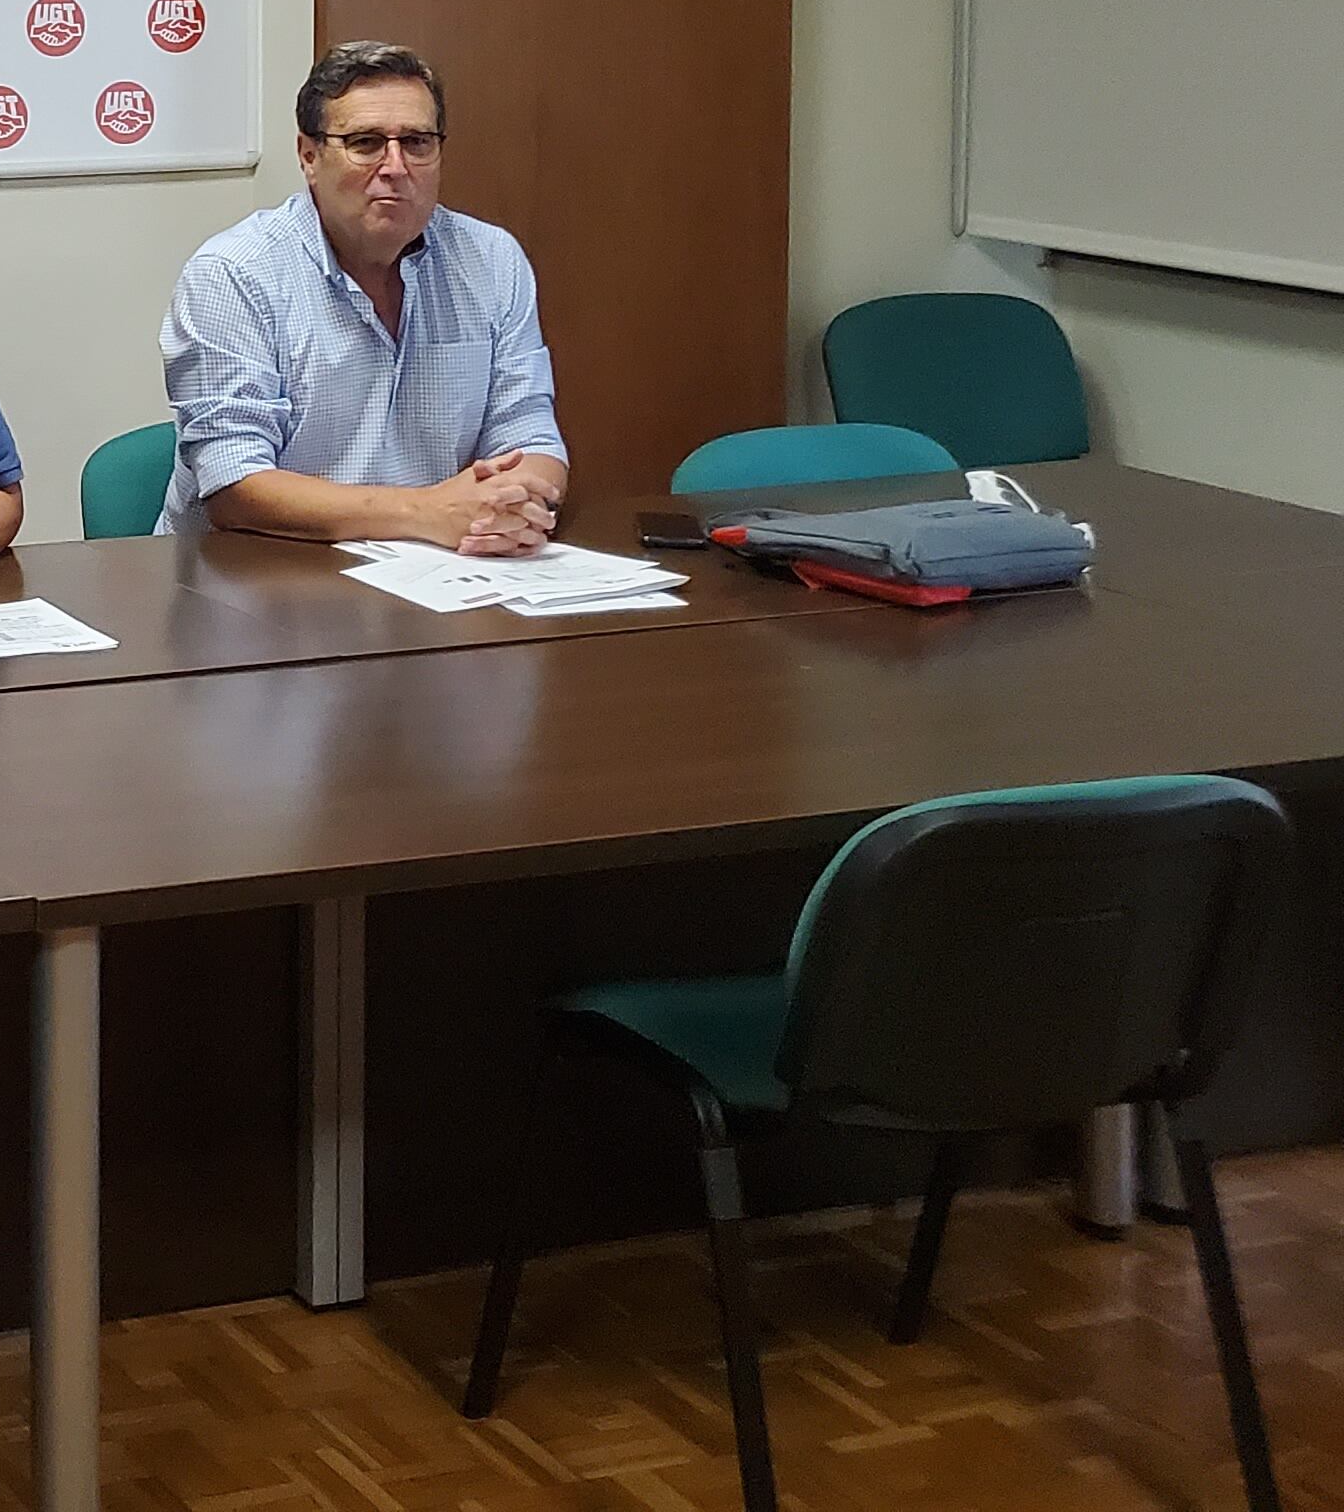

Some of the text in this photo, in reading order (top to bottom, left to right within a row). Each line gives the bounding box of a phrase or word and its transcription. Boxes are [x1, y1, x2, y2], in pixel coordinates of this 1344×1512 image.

[35, 3, 75, 26] UGT
[156, 0, 196, 22] UGT
[104, 91, 145, 113] UGT
